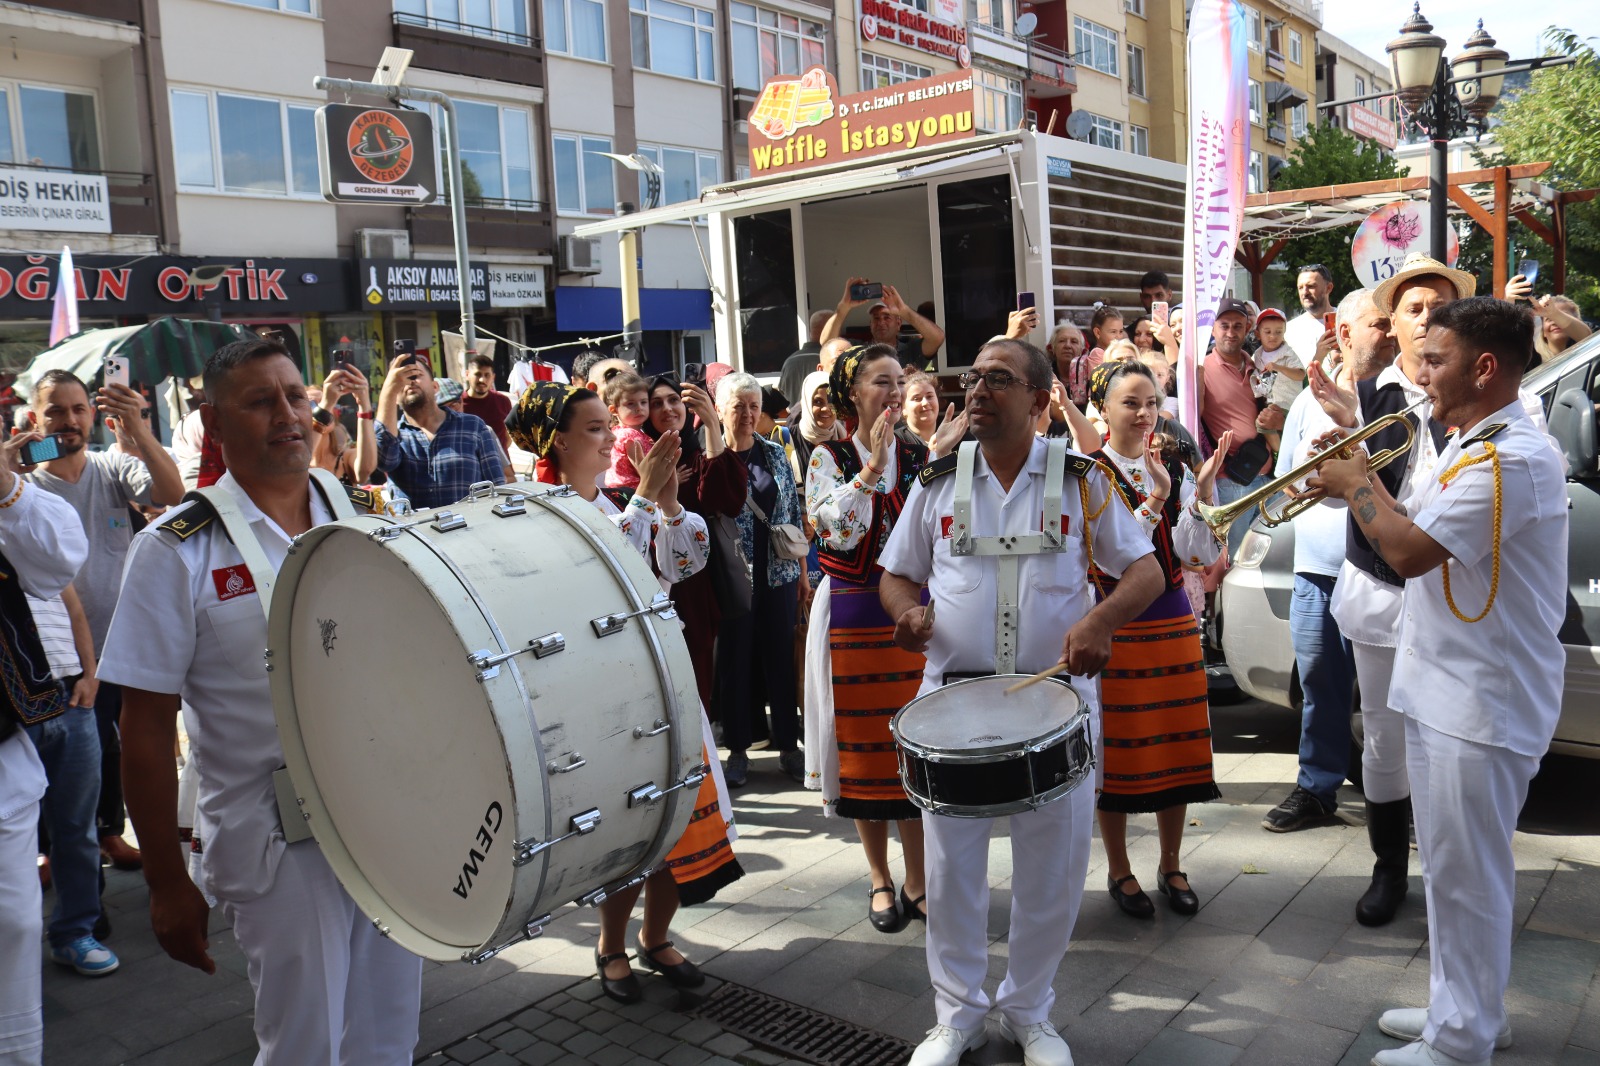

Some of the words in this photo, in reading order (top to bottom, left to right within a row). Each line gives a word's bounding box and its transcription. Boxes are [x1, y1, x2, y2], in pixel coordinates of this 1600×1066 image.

[897, 8, 929, 34] BİRLİK
[929, 24, 967, 45] PARTİSİ
[907, 76, 973, 103] BELEDİYESİ
[355, 113, 393, 130] KAHVE
[752, 133, 828, 171] Waffle
[841, 110, 973, 154] İstasyonu
[36, 180, 102, 203] HEKİMİ
[354, 186, 388, 195] GEZEGENİ
[391, 188, 416, 196] KEŞFET
[1, 204, 39, 218] BERRİN
[43, 206, 73, 221] ÇINAR
[74, 206, 104, 221] GİRAL
[306, 274, 313, 283] 5
[387, 266, 427, 286] AKSOY
[430, 267, 485, 286] ANAHAR
[488, 270, 501, 284] DİŞ
[505, 271, 537, 283] HEKİMİ
[1371, 257, 1395, 282] 13
[387, 287, 425, 303] ÇİLİNGİR
[431, 290, 450, 301] 0544
[517, 289, 542, 299] ÖZKAN
[452, 800, 503, 900] GEWA
